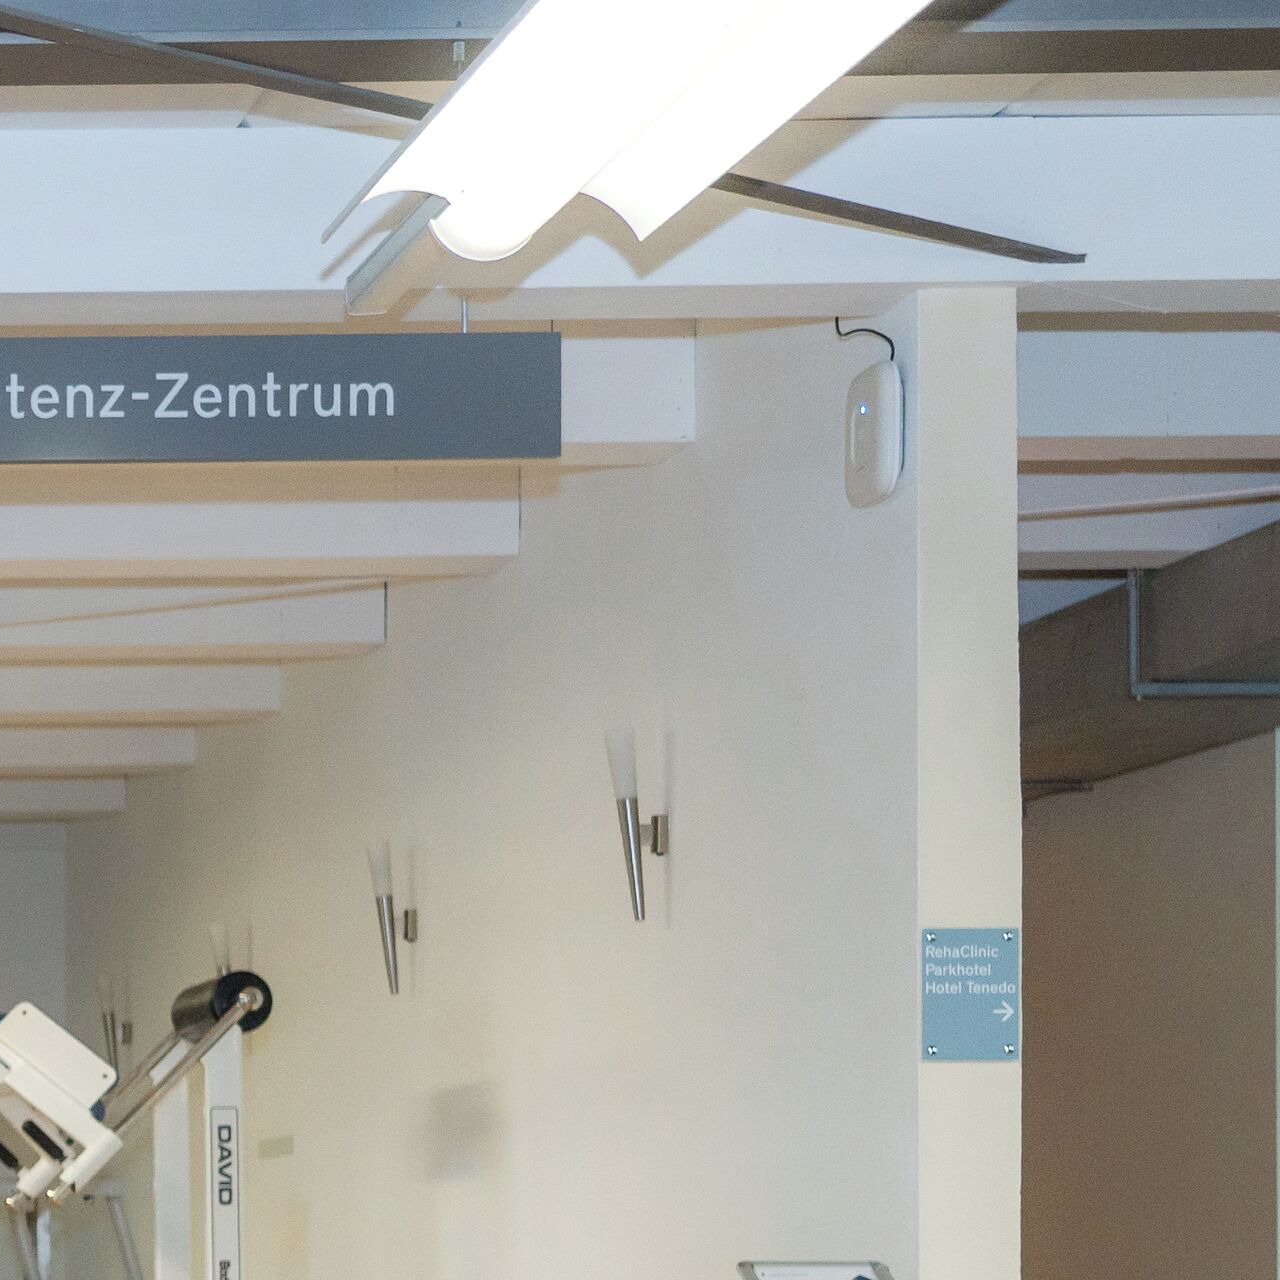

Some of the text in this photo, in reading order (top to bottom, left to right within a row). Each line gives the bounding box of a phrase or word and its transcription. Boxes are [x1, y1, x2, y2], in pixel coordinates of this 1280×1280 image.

[925, 945, 999, 958] RehaClinic
[925, 963, 992, 976] Parkhotel
[925, 981, 1016, 994] Hotel Tenedo
[217, 1124, 233, 1206] DAVID
